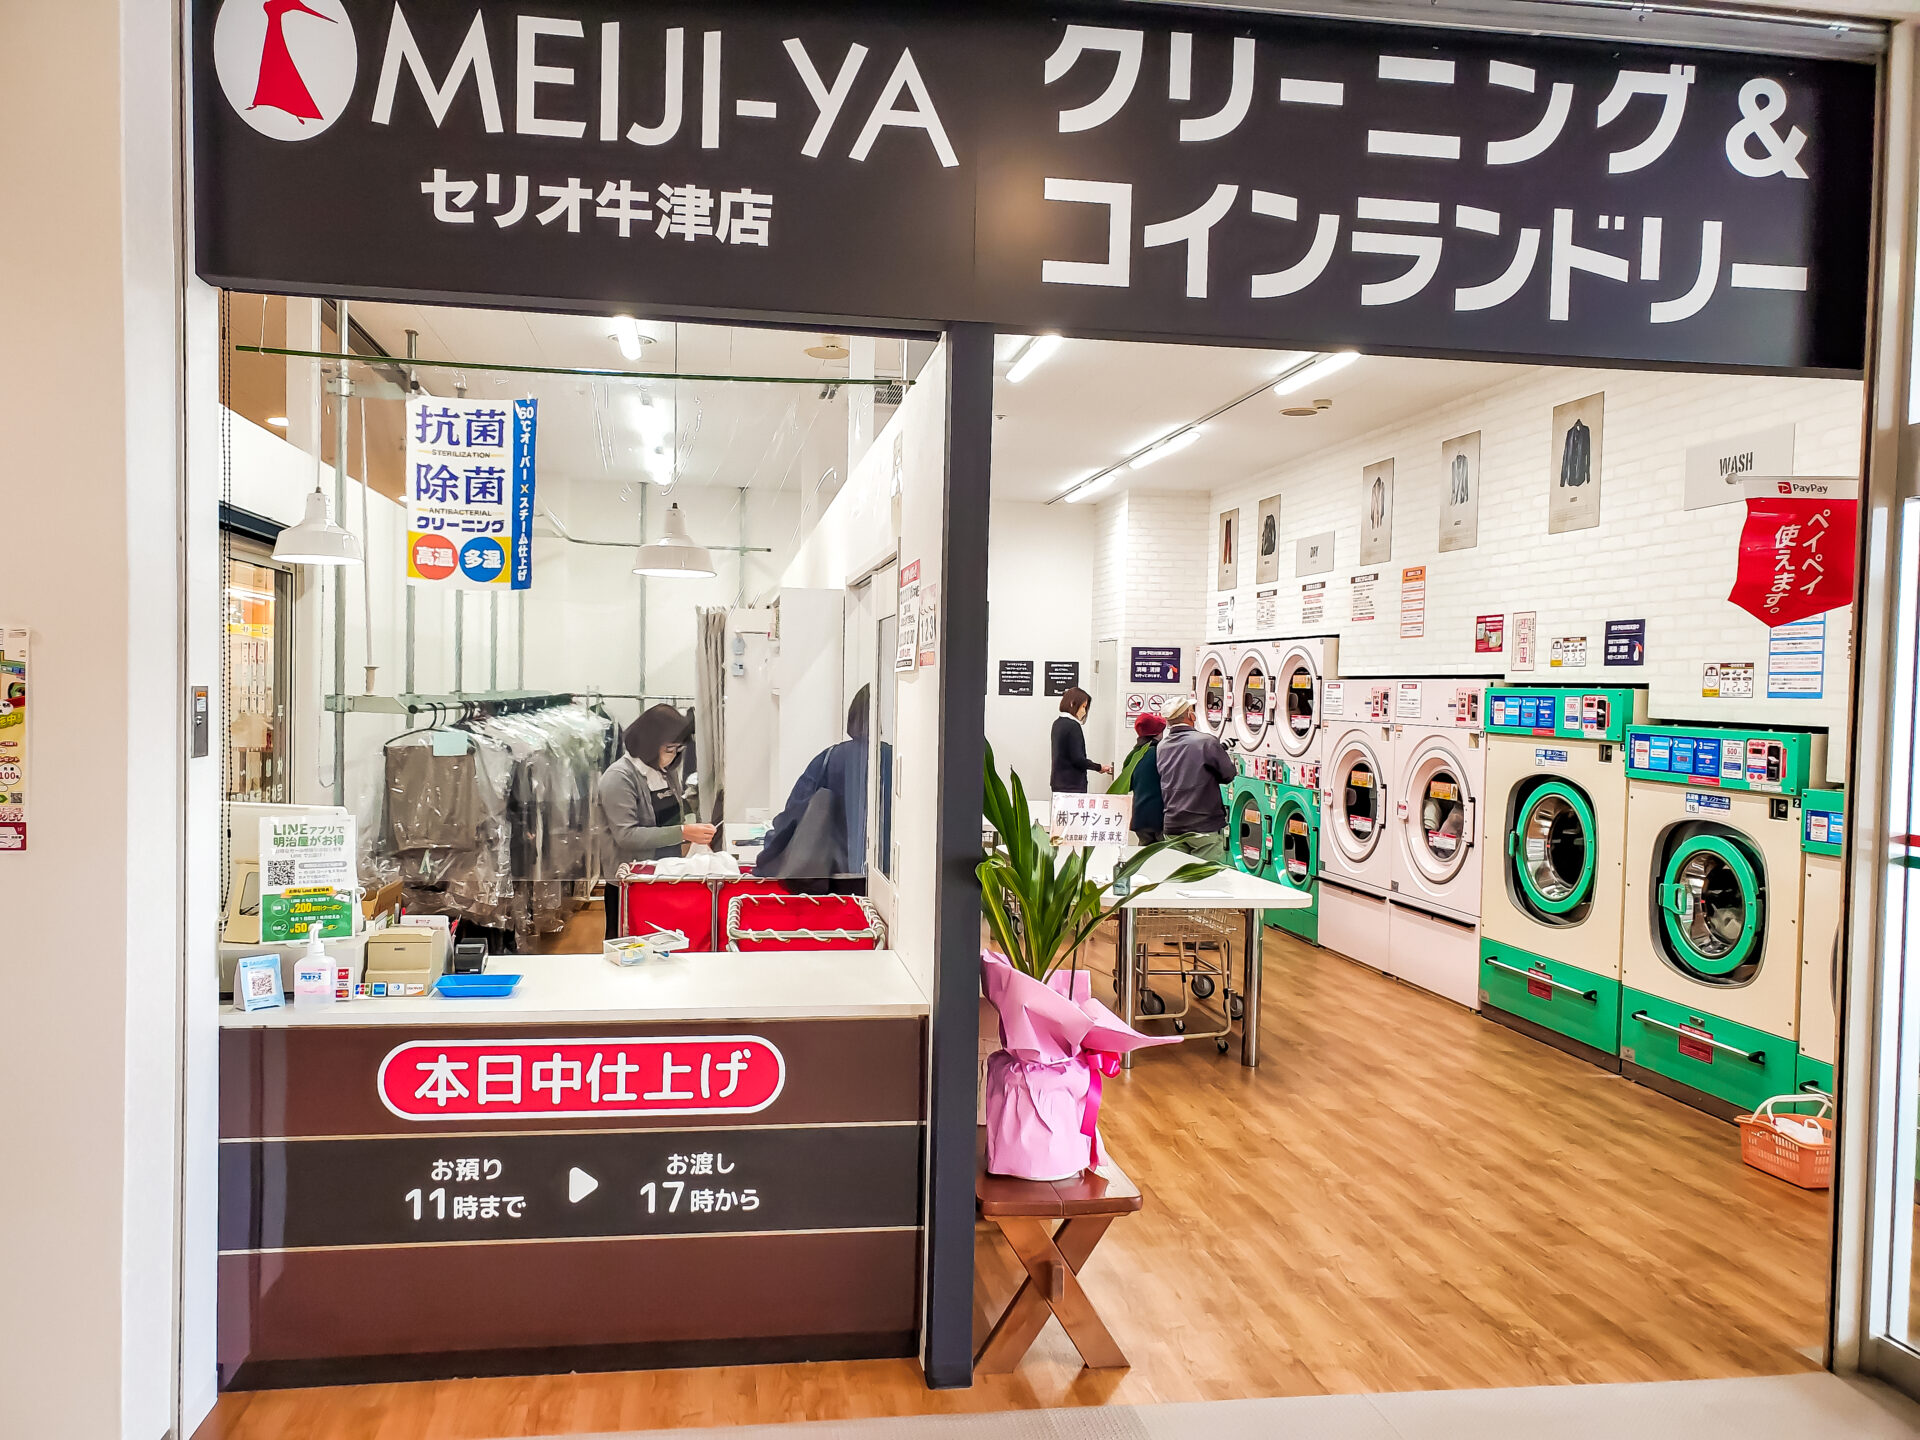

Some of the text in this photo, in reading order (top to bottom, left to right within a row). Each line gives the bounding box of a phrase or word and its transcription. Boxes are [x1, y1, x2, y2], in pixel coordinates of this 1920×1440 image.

[371, 0, 960, 168] MEIJI-YA
[1044, 24, 1809, 180] クリーニング &
[421, 168, 773, 247] セリオ牛津店
[1042, 177, 1808, 325] コインランドリー
[415, 404, 506, 448] 抗菌
[432, 449, 491, 459] STERILIZATION
[1719, 451, 1754, 477] WASH
[416, 463, 506, 506] 除菌
[1793, 483, 1828, 494] PayPay
[416, 516, 505, 533] クリーニング
[429, 508, 492, 517] ANTIBACTERIAL
[416, 546, 454, 568] 高温
[464, 549, 502, 569] 多湿
[1800, 508, 1831, 596] ペイペイ
[1794, 799, 1799, 808] 2
[273, 835, 345, 848] 明治屋がお得
[415, 1048, 752, 1107] 本日中仕上げ
[430, 1152, 736, 1182] お預り お渡し
[405, 1181, 761, 1221] 11時まで 17時から
